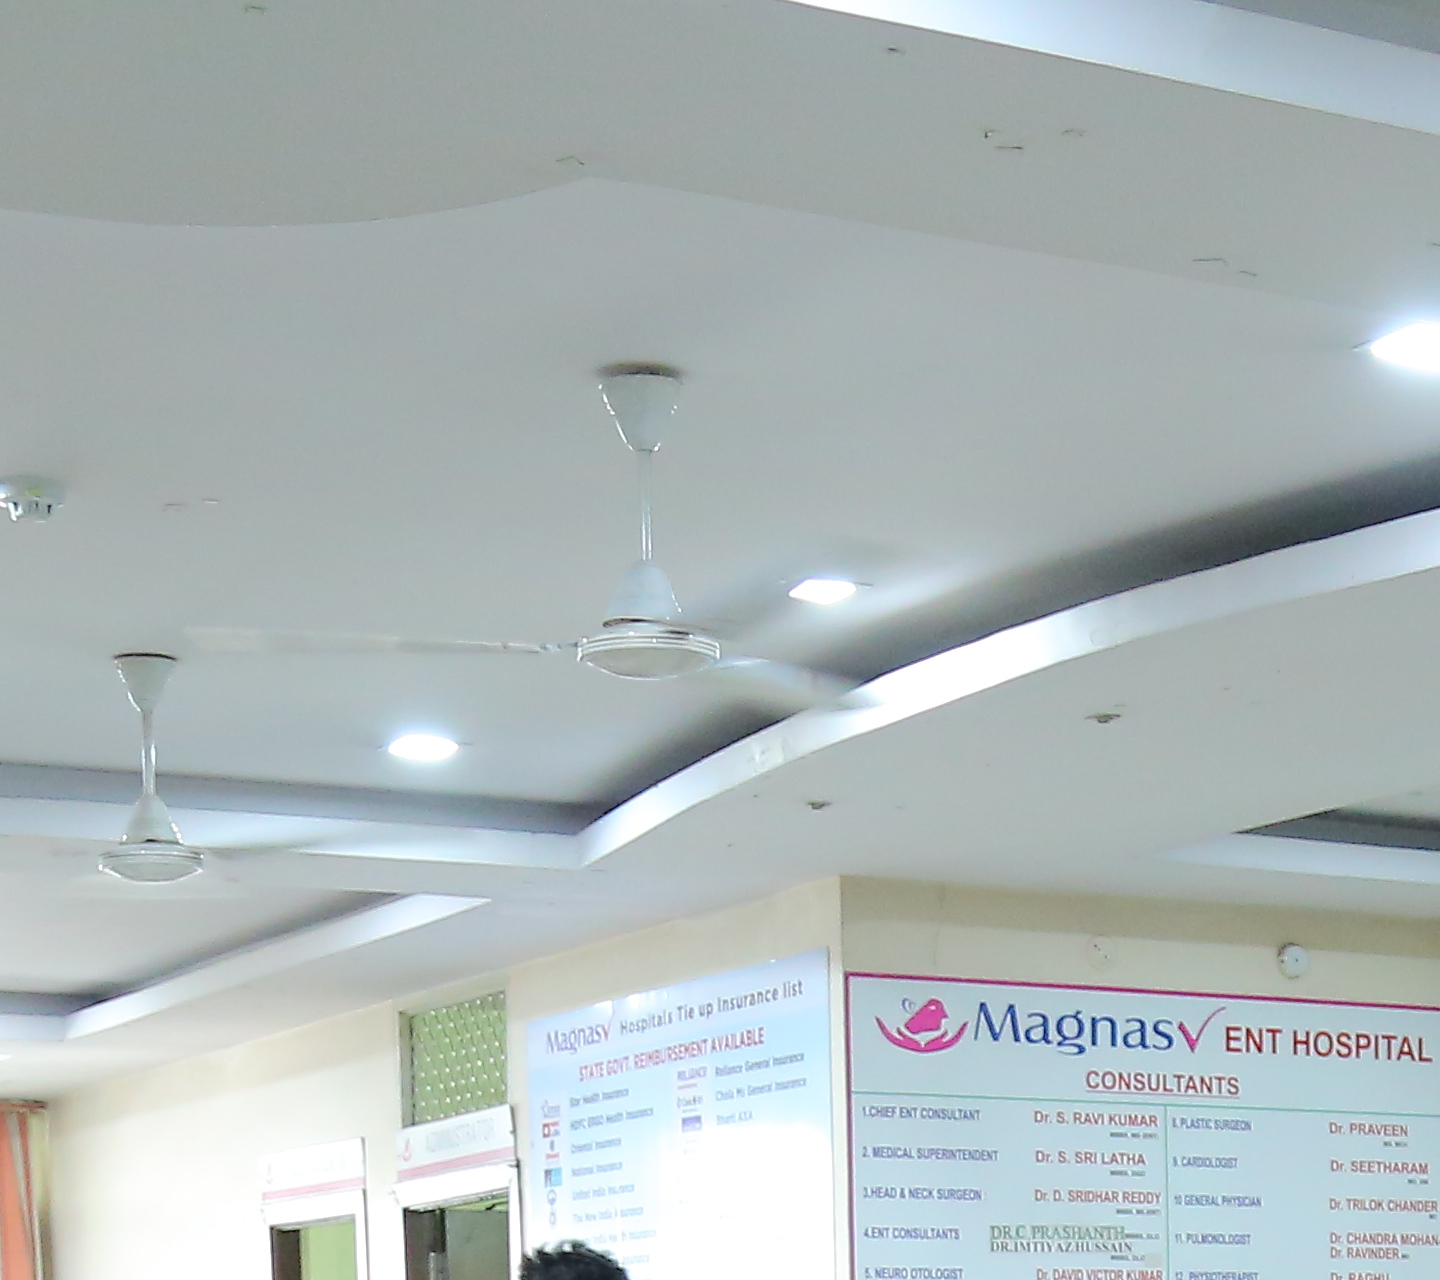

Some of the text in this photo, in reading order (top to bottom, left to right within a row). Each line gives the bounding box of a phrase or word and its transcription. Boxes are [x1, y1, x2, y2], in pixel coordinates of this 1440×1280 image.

[620, 1009, 673, 1036] Hospitals
[677, 1004, 694, 1021] Tie
[698, 1002, 714, 1019] up
[717, 989, 779, 1014] Insurance
[783, 978, 804, 999] list
[1225, 1026, 1283, 1054] ENT
[1292, 1029, 1433, 1062] HOSPITAL
[579, 1062, 605, 1082] STATE
[634, 1039, 708, 1069] REIMBURSEMENT
[711, 1027, 765, 1053] AVAILABLE
[1085, 1070, 1240, 1096] CONSULTANTS
[899, 1107, 918, 1119] ENT
[920, 1108, 980, 1121] CONSULTANT
[1034, 1110, 1158, 1127] Dr. S. RAVI KUMAR
[1180, 1118, 1212, 1130] PLASTIC
[1214, 1119, 1252, 1131] SURGEON
[1329, 1122, 1408, 1137] Dr. PRAVEEN
[862, 1147, 998, 1161] 2. MEDICAL SUPERINTENDENT
[1035, 1150, 1146, 1166] Dr. S. SRI LATHA
[1181, 1157, 1238, 1169] CARDIOLOGIST
[1331, 1160, 1429, 1175] Dr. SEETHARAM
[909, 1188, 934, 1200] NECK
[937, 1188, 982, 1201] SURGEON
[1034, 1189, 1162, 1205] Dr. D. SRIDHAR REDDY
[1184, 1196, 1220, 1207] GENERAL
[1222, 1197, 1262, 1208] PHYSICIAN
[1330, 1199, 1438, 1213] Dr. TRILOK CHANDER
[893, 1227, 960, 1241] CONSULTANTS
[1031, 1225, 1125, 1241] PRASHANTH
[1186, 1234, 1251, 1245] PULMONOLOGIST
[1330, 1232, 1439, 1246] Dr. CHANDRA MOHAN
[1330, 1247, 1400, 1259] Dr. RAVINDER
[874, 1267, 908, 1279] NEURO
[910, 1268, 964, 1280] OTOLOGIST
[1036, 1268, 1050, 1280] Dr.
